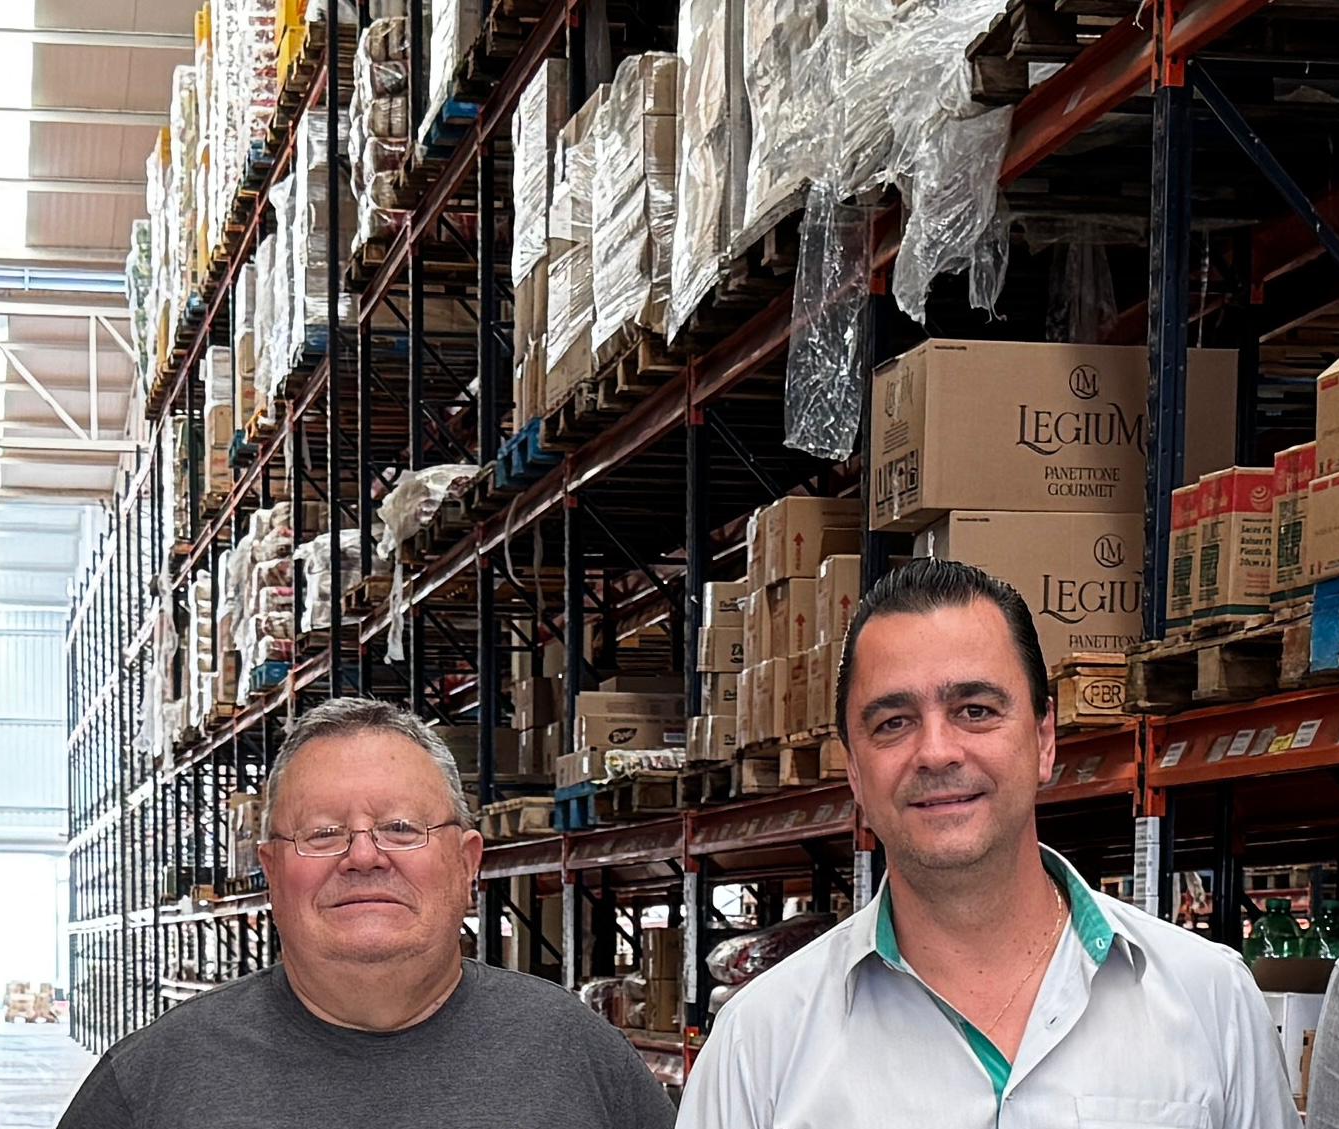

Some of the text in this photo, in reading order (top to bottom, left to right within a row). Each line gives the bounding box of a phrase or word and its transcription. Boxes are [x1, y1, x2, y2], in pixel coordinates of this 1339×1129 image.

[1015, 402, 1146, 456] LEGIUM
[1045, 466, 1120, 481] PANETTONE
[1048, 483, 1116, 498] GOURMET
[1039, 573, 1142, 624] LEGIU
